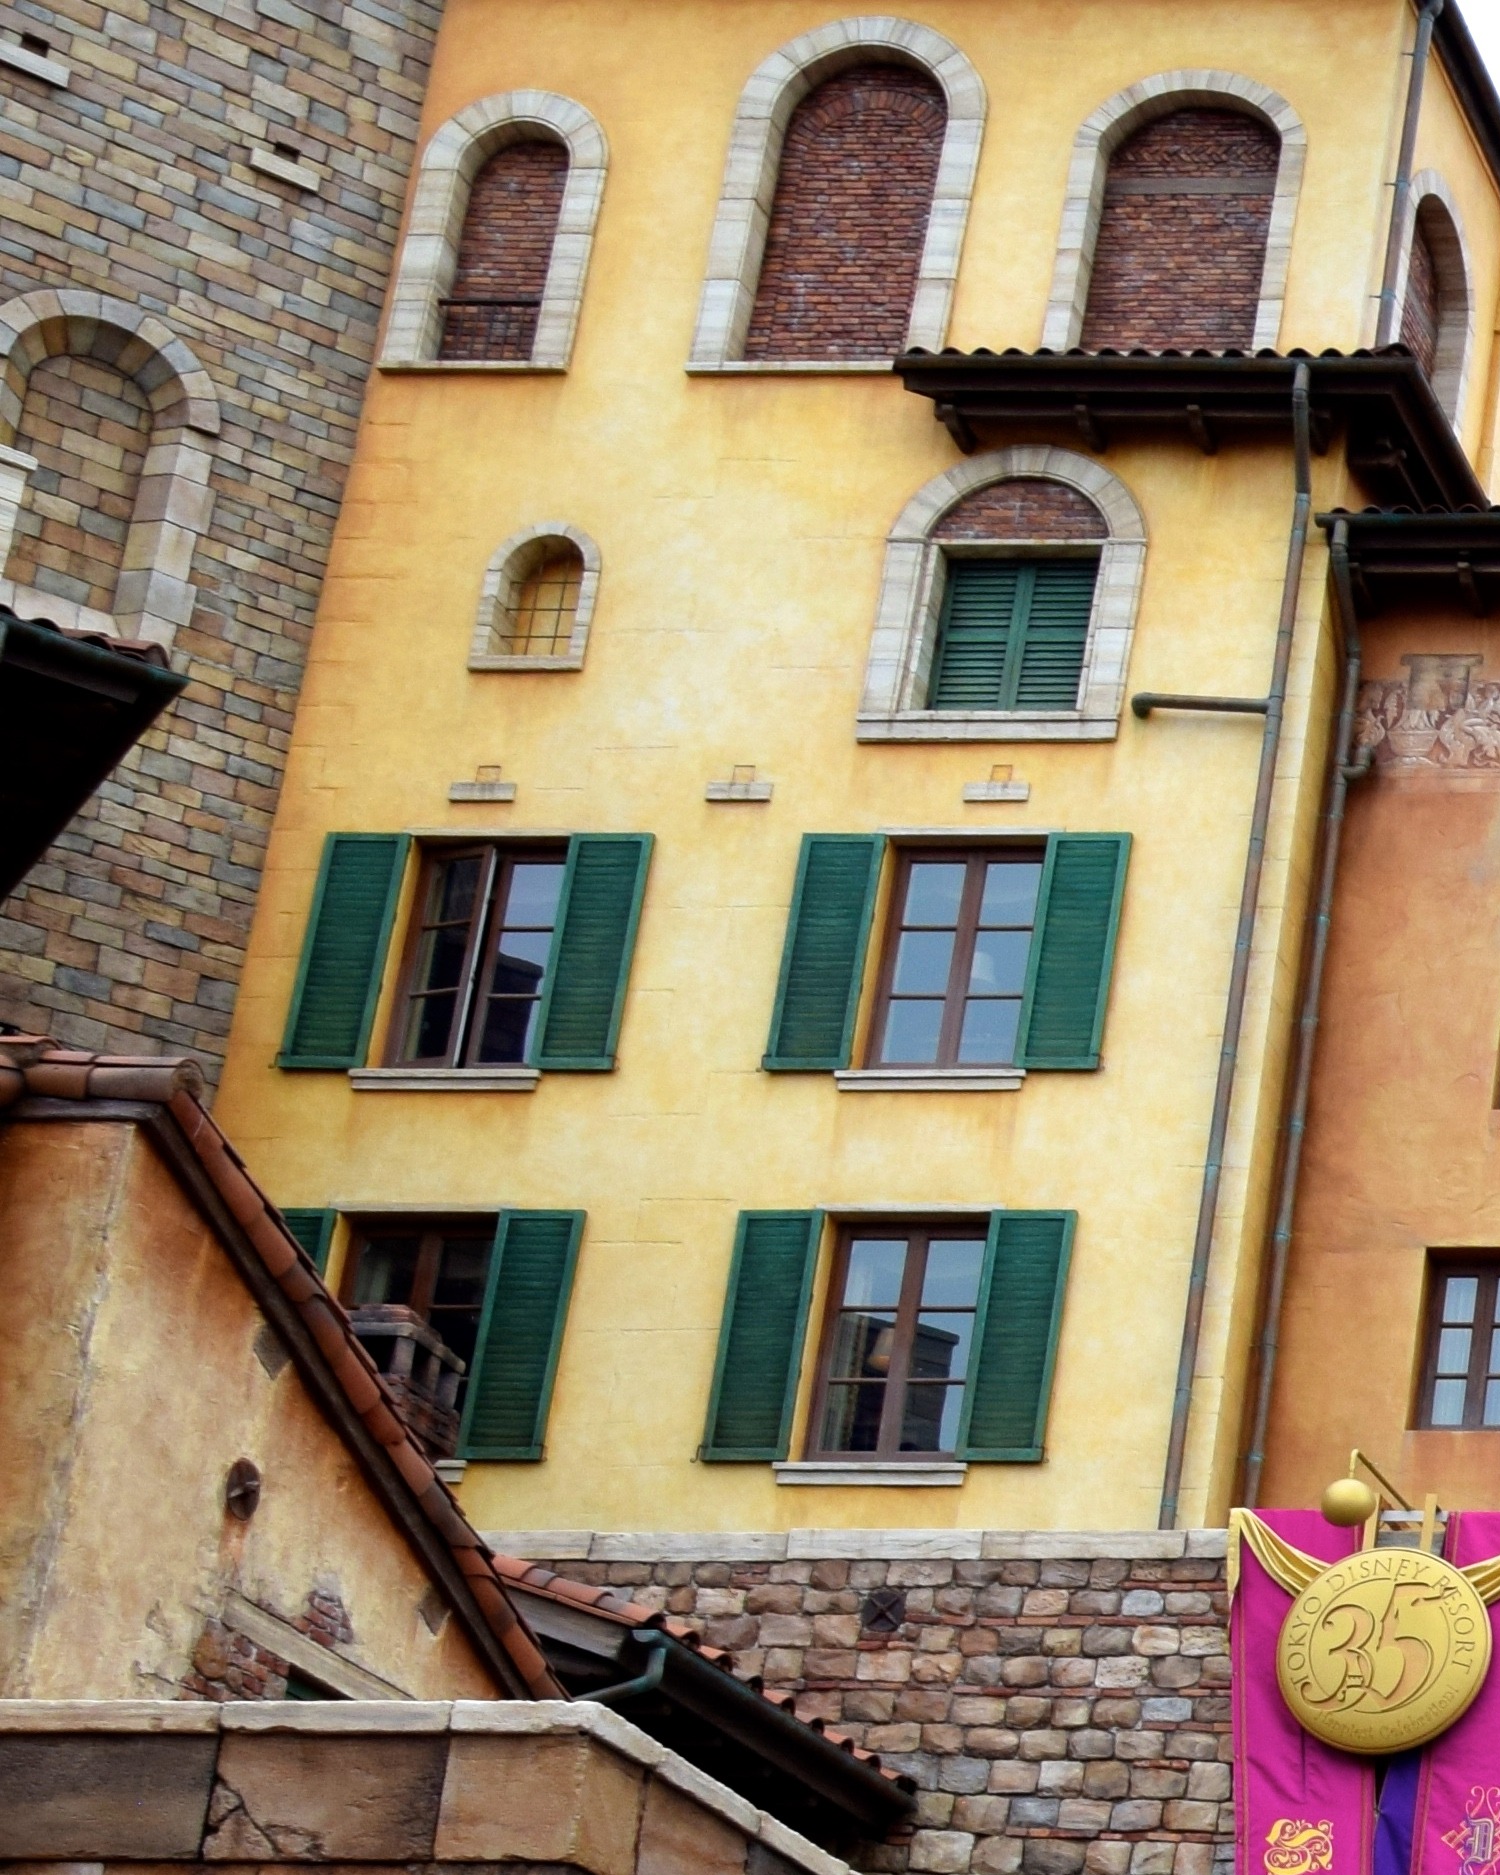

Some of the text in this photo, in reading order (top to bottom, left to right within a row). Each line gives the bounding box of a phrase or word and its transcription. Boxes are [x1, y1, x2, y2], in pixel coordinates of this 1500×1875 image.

[1287, 1557, 1477, 1691] TOKYO DISNEY RESORT
[1300, 1581, 1459, 1714] 35
